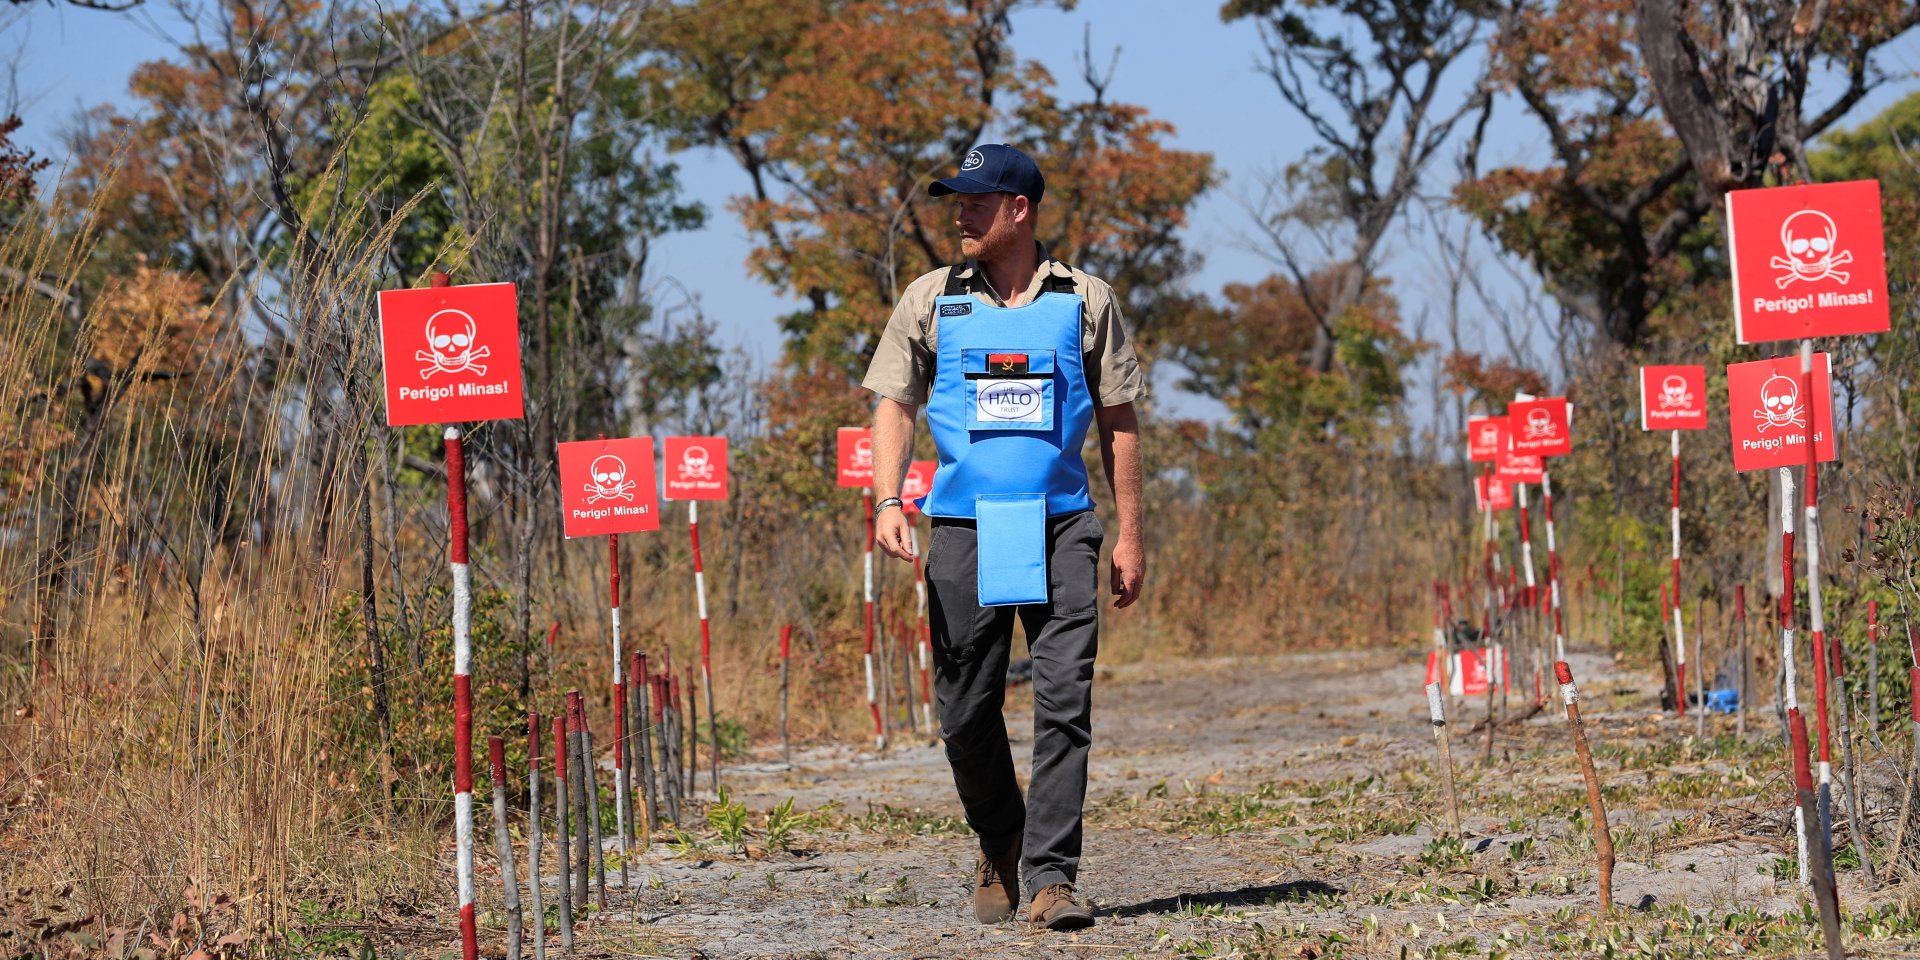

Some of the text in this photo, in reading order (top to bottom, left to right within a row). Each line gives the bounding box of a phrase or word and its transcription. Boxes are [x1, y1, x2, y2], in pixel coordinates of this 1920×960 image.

[1753, 289, 1873, 314] Perigo! Minas!
[399, 381, 508, 401] Perigo! Minas!
[988, 392, 1032, 406] HALO
[1742, 431, 1823, 450] Perigo! Mins!
[573, 504, 649, 520] Perigo! Minas!
